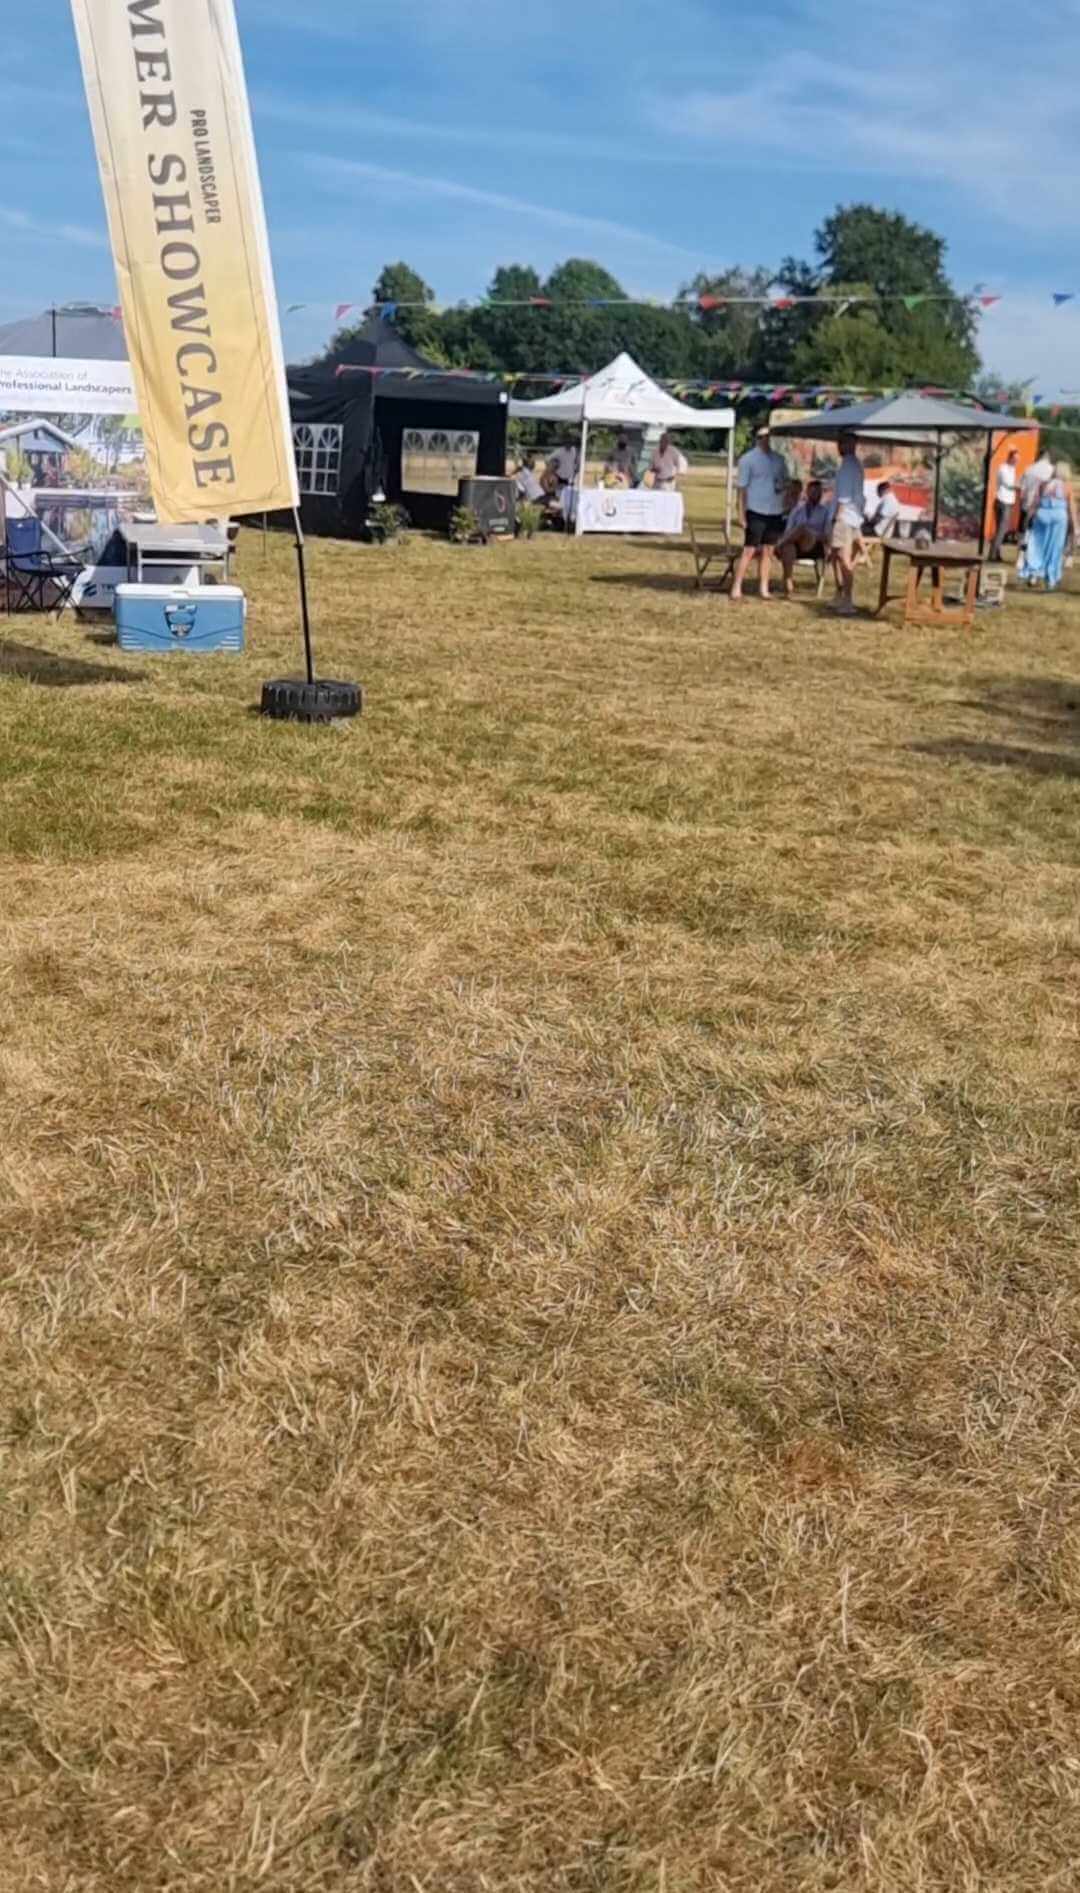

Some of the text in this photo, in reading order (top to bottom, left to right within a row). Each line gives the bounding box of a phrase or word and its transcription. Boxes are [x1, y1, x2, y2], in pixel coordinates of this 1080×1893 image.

[190, 108, 221, 224] PRO LANDSCAPER
[147, 152, 236, 489] SHOWCASE
[0, 378, 132, 396] rofessional Landscapers
